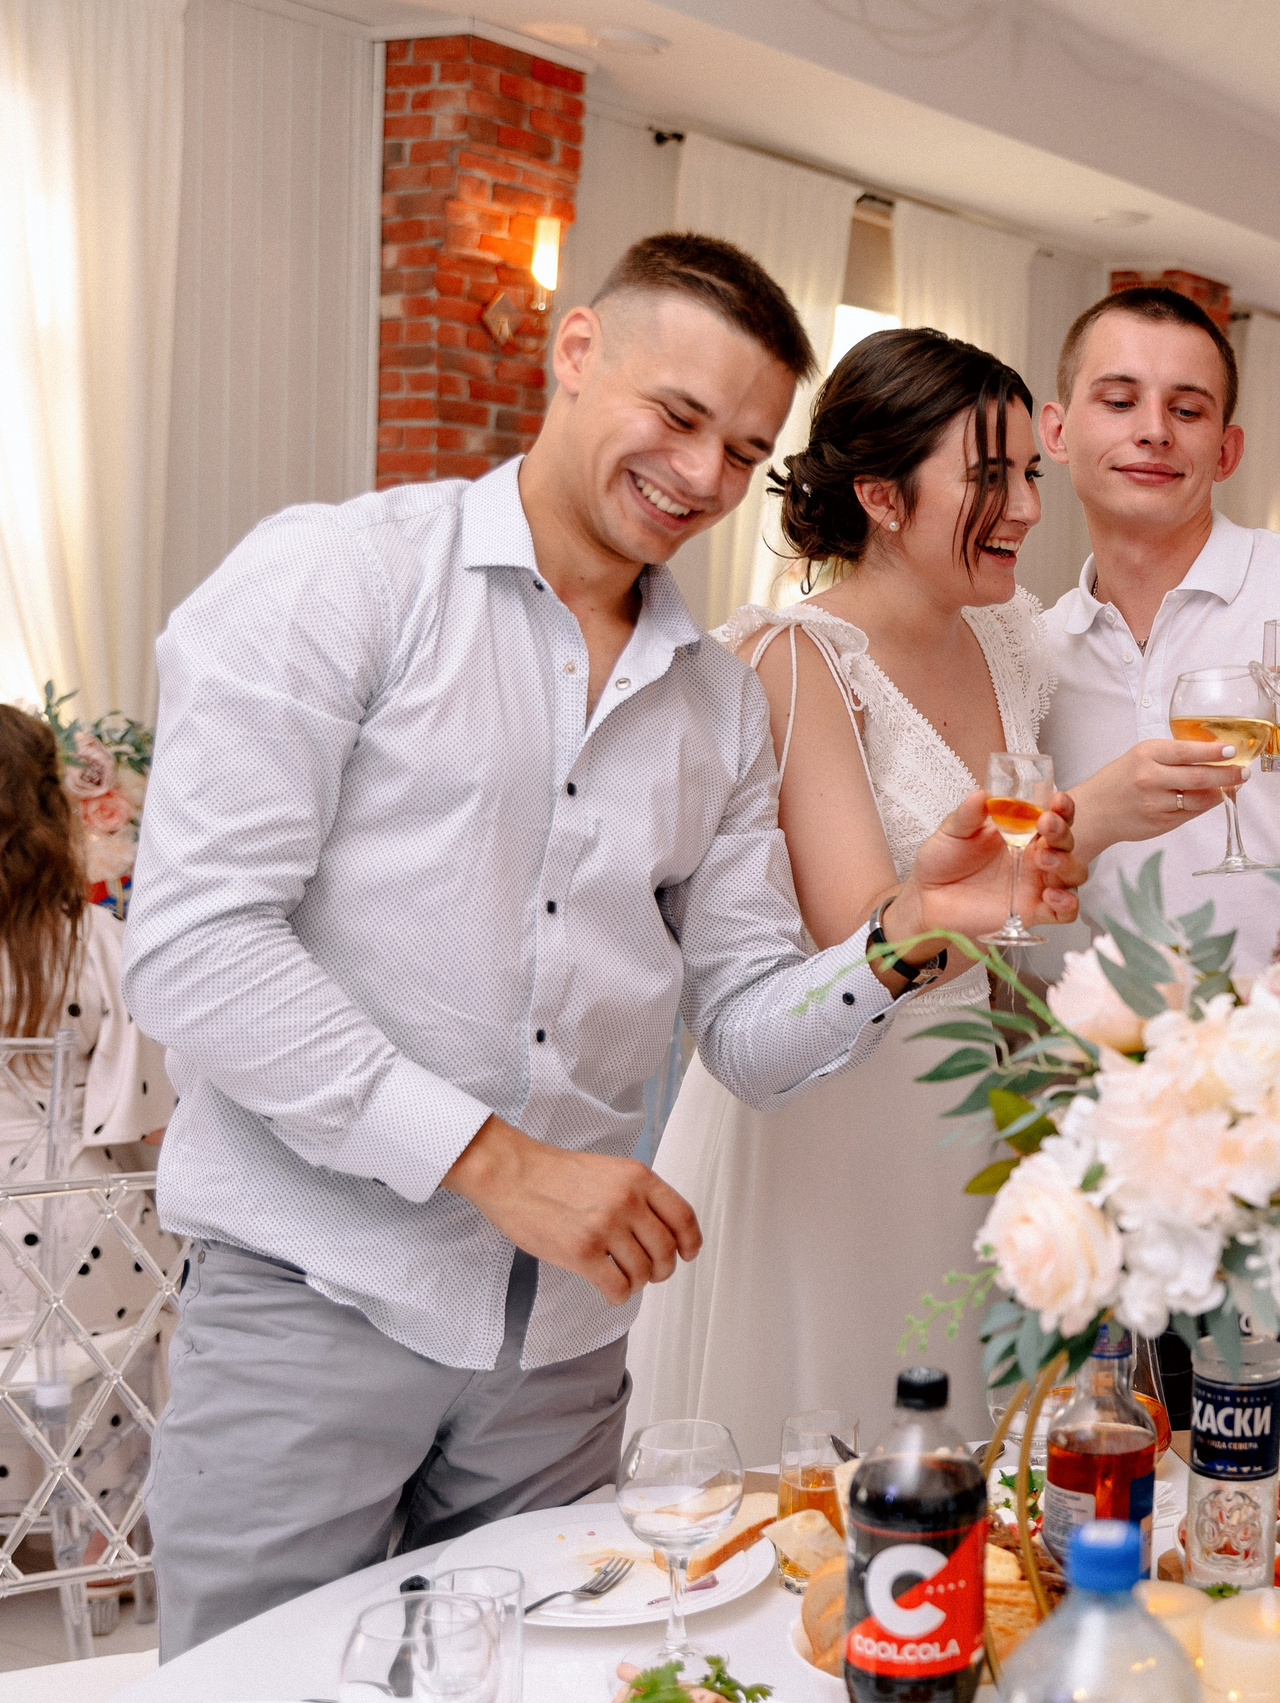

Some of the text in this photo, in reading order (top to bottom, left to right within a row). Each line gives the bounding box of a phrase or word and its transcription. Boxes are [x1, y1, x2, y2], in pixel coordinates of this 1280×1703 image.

[1191, 1397, 1271, 1437] ХАСКИ
[864, 1543, 949, 1640] C
[852, 1634, 961, 1665] COOLCOLA
